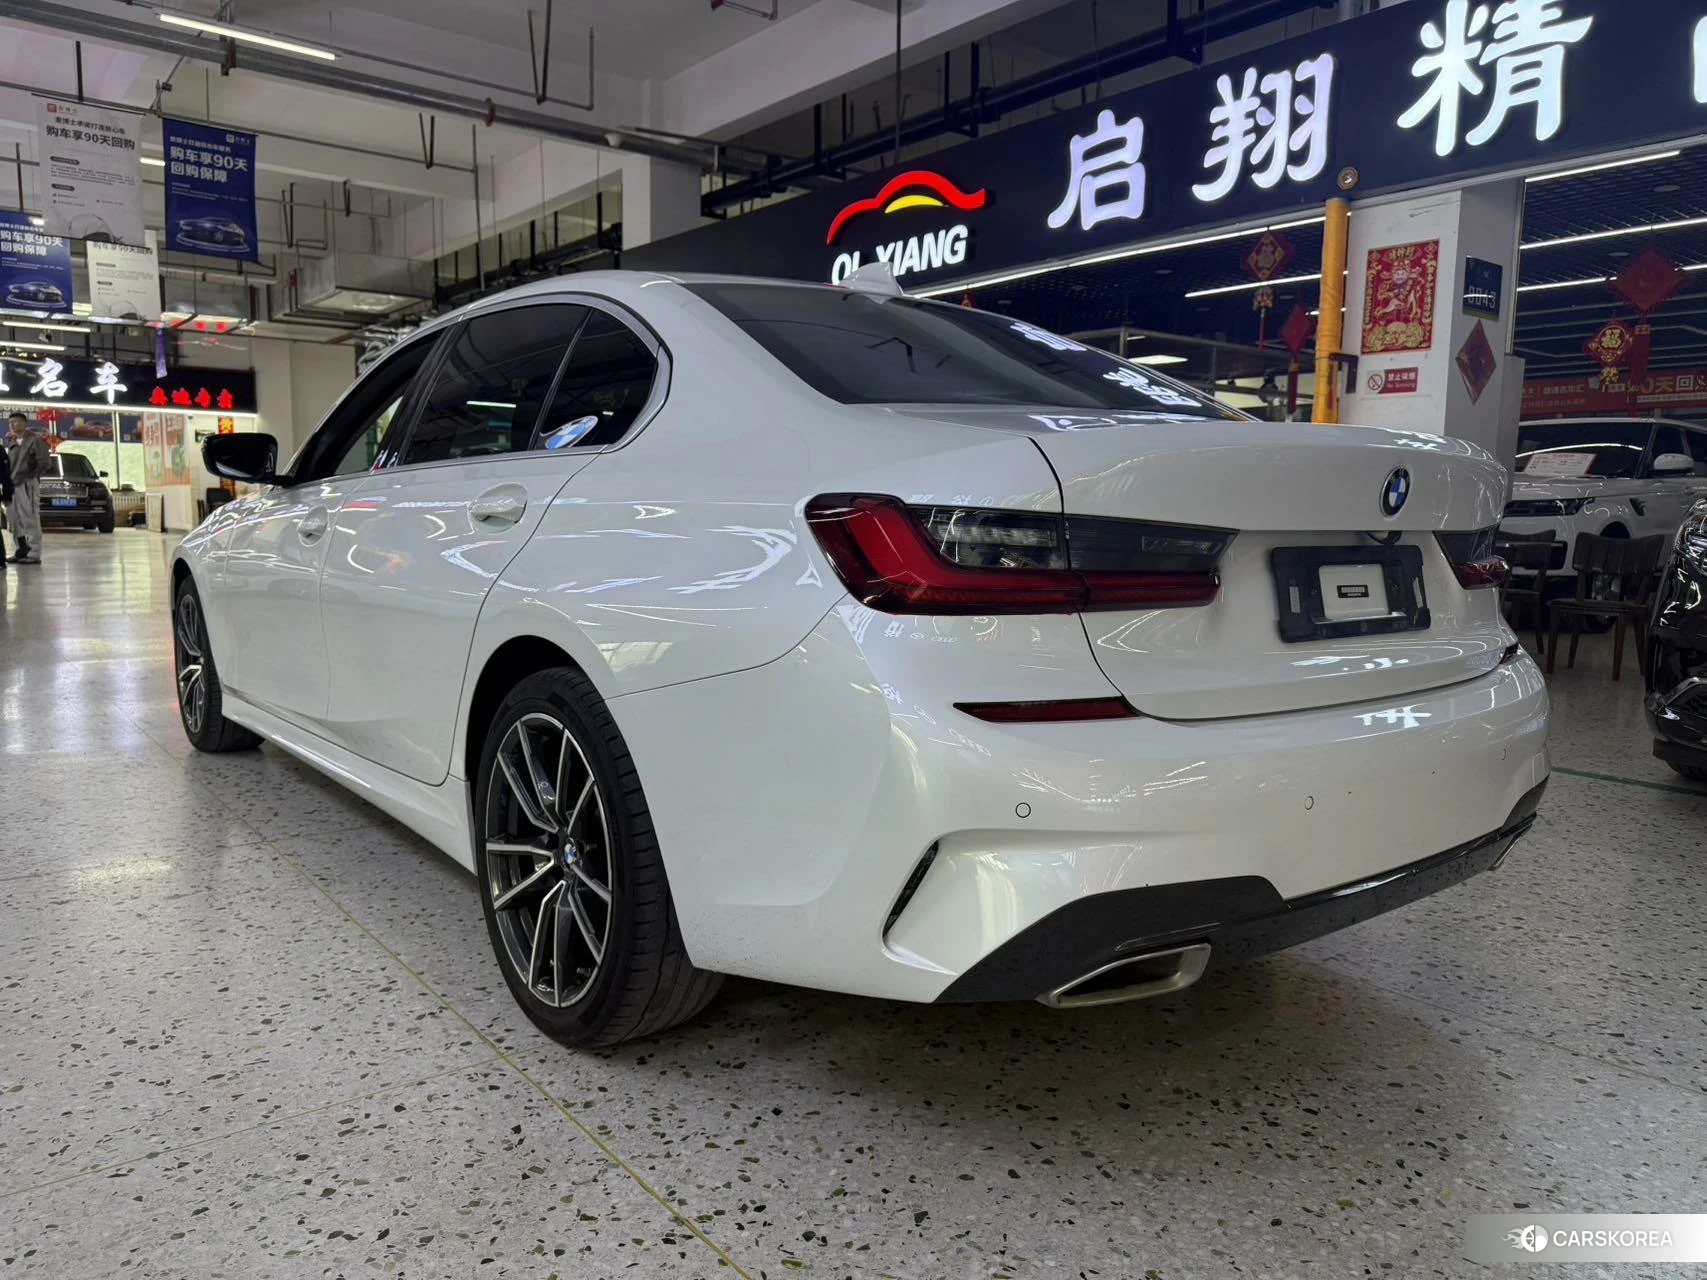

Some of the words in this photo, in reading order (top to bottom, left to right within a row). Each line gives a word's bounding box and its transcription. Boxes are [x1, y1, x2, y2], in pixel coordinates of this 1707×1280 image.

[1047, 0, 1707, 231] 启翔精
[46, 124, 136, 150] 购车享90天回购
[170, 146, 248, 171] 购车享90天
[171, 162, 228, 183] 回购保障
[0, 230, 64, 247] 购车享90天
[0, 241, 48, 256] 回购保障
[0, 358, 128, 405] 名车
